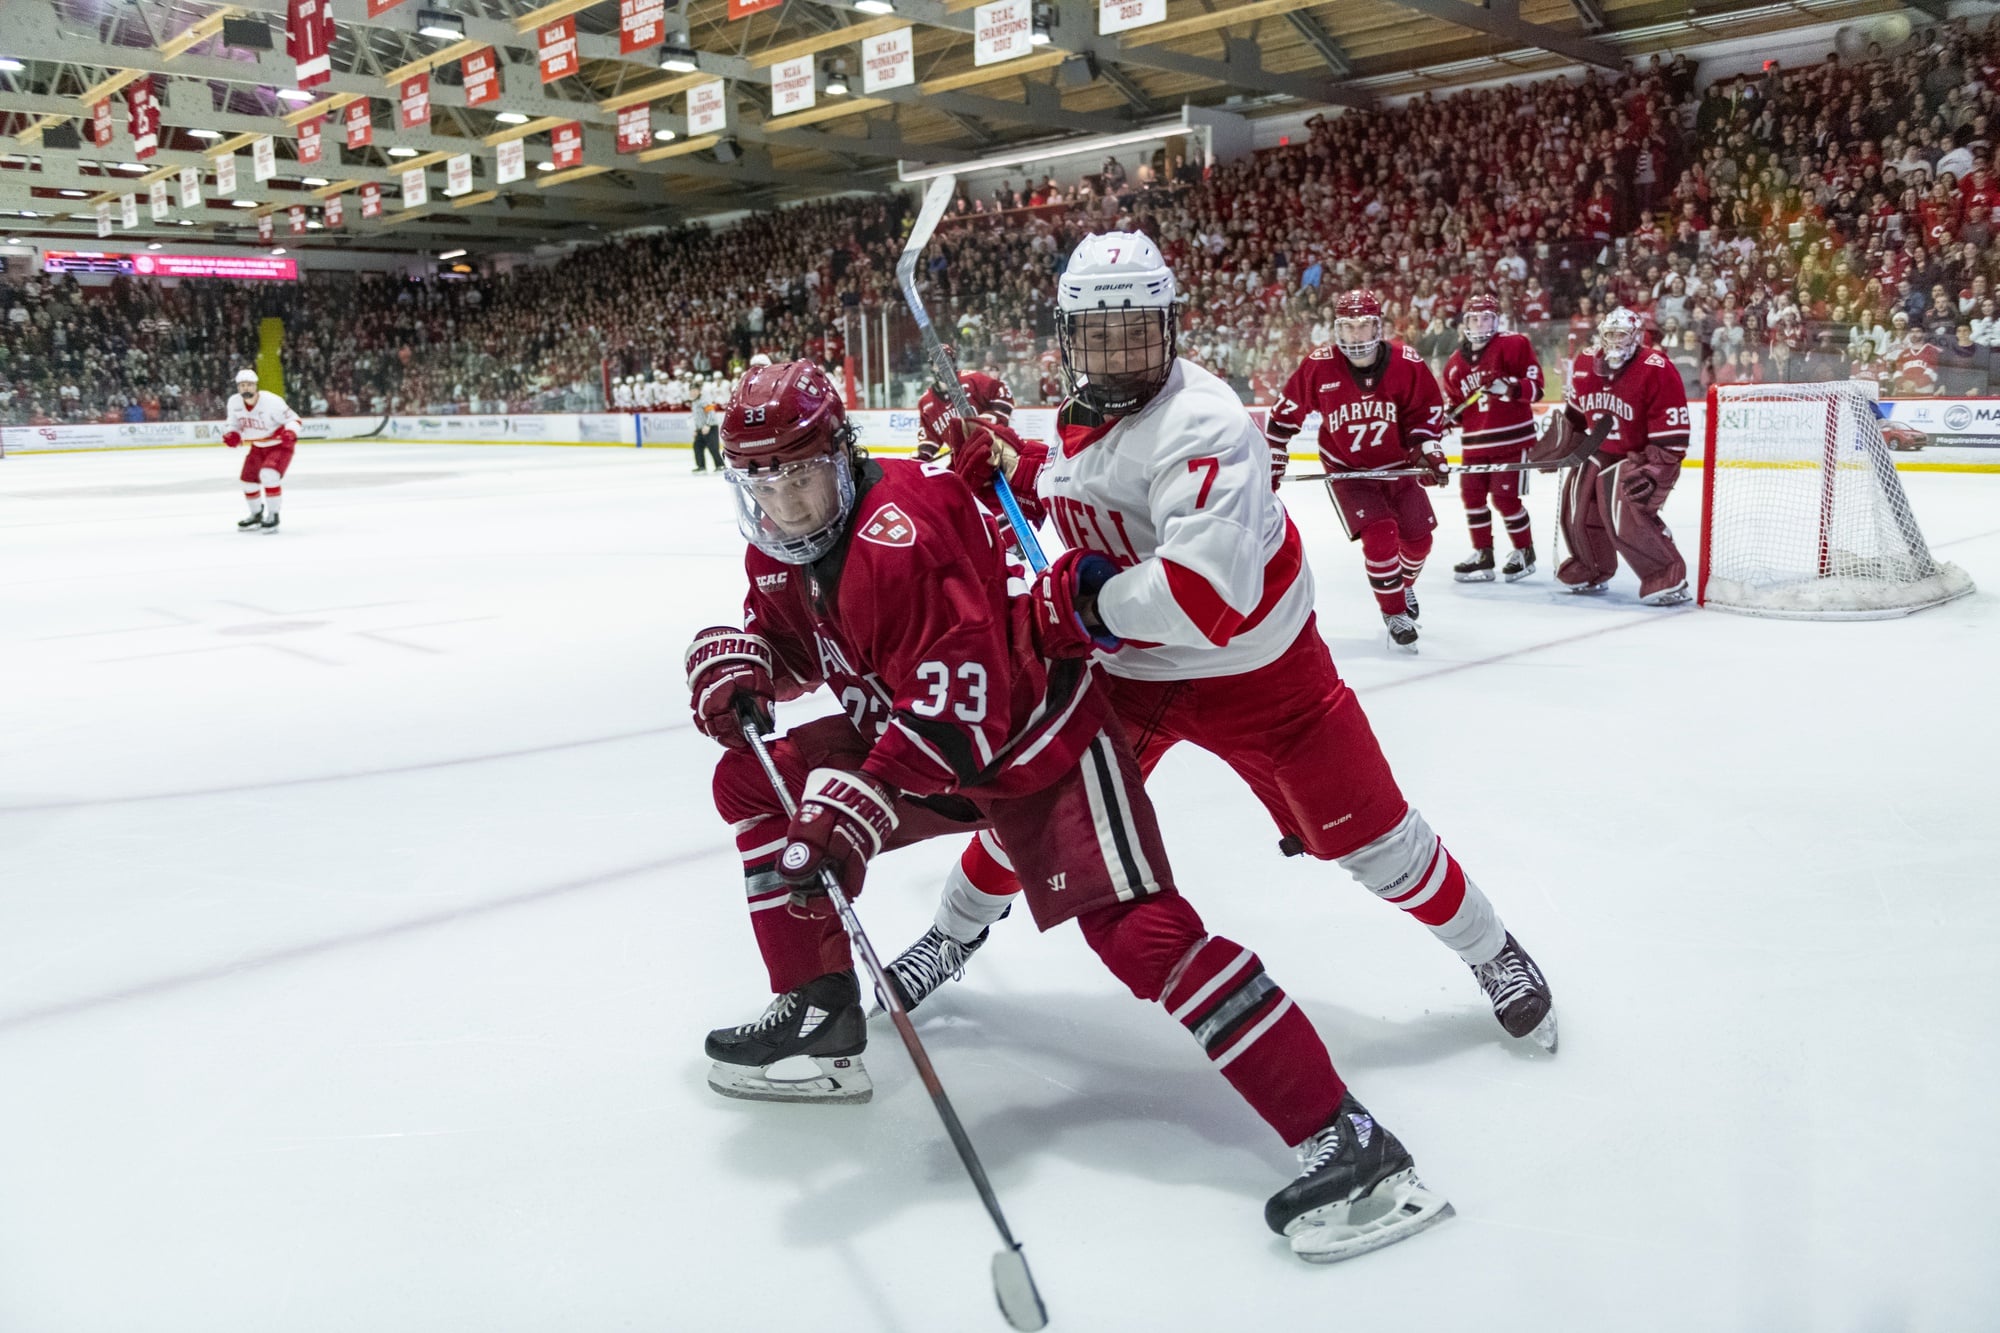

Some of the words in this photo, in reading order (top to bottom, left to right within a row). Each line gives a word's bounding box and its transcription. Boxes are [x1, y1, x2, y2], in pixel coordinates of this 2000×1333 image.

[991, 7, 1014, 24] ECAC
[979, 18, 1028, 42] CHAMPIONS
[877, 41, 897, 54] NCAA
[993, 38, 1011, 53] 2013
[1107, 248, 1121, 264] 7
[1094, 283, 1133, 292] BAUER
[1526, 365, 1538, 380] 2
[1578, 392, 1634, 421] HARVARD
[744, 407, 766, 424] 33
[1328, 400, 1397, 433] HARVAR
[1666, 407, 1690, 426] 32
[740, 437, 776, 449] WARRIOR
[1347, 421, 1389, 453] 77
[1187, 456, 1220, 510] 7
[1328, 471, 1388, 479] JETSPEED
[911, 660, 987, 723] 33
[1322, 813, 1352, 830] BAUER
